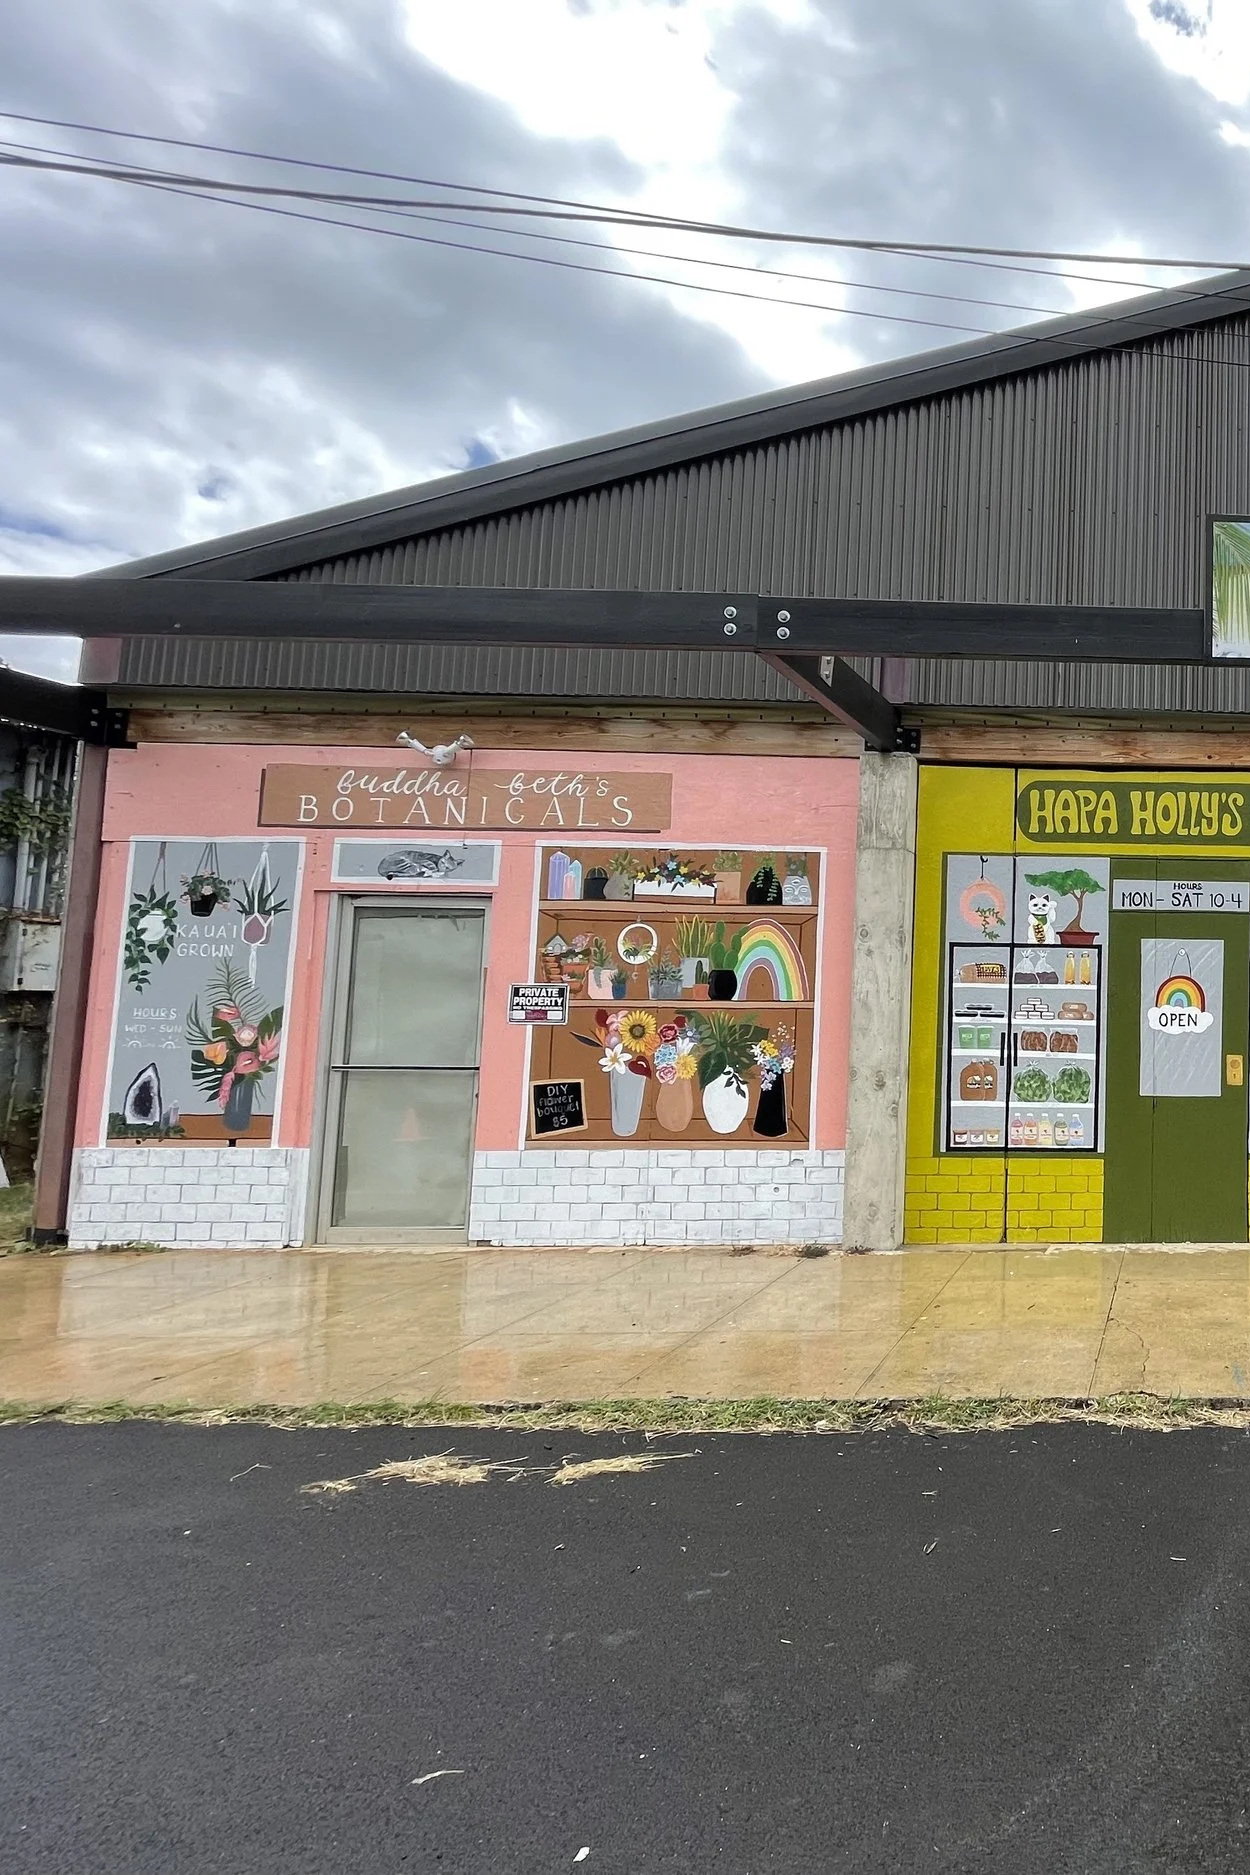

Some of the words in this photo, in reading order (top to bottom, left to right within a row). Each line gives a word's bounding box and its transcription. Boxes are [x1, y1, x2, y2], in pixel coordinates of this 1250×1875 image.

[336, 769, 467, 797] buddha
[494, 771, 610, 798] beth's
[297, 794, 634, 827] BOTANICALS
[1028, 789, 1119, 834] HAPA
[1130, 790, 1245, 837] HOLLY'S
[1173, 882, 1203, 891] HOURS
[1121, 891, 1153, 908] MON
[1171, 892, 1204, 908] SAT
[1209, 893, 1243, 909] 10-4
[176, 943, 234, 957] GROWN
[519, 988, 560, 997] PRIVATE
[513, 997, 563, 1006] PROPERTY
[133, 1008, 177, 1019] HOURS
[1158, 1013, 1198, 1027] OPEN
[125, 1024, 147, 1033] WED
[159, 1024, 182, 1033] SUN
[547, 1084, 568, 1097] DIY
